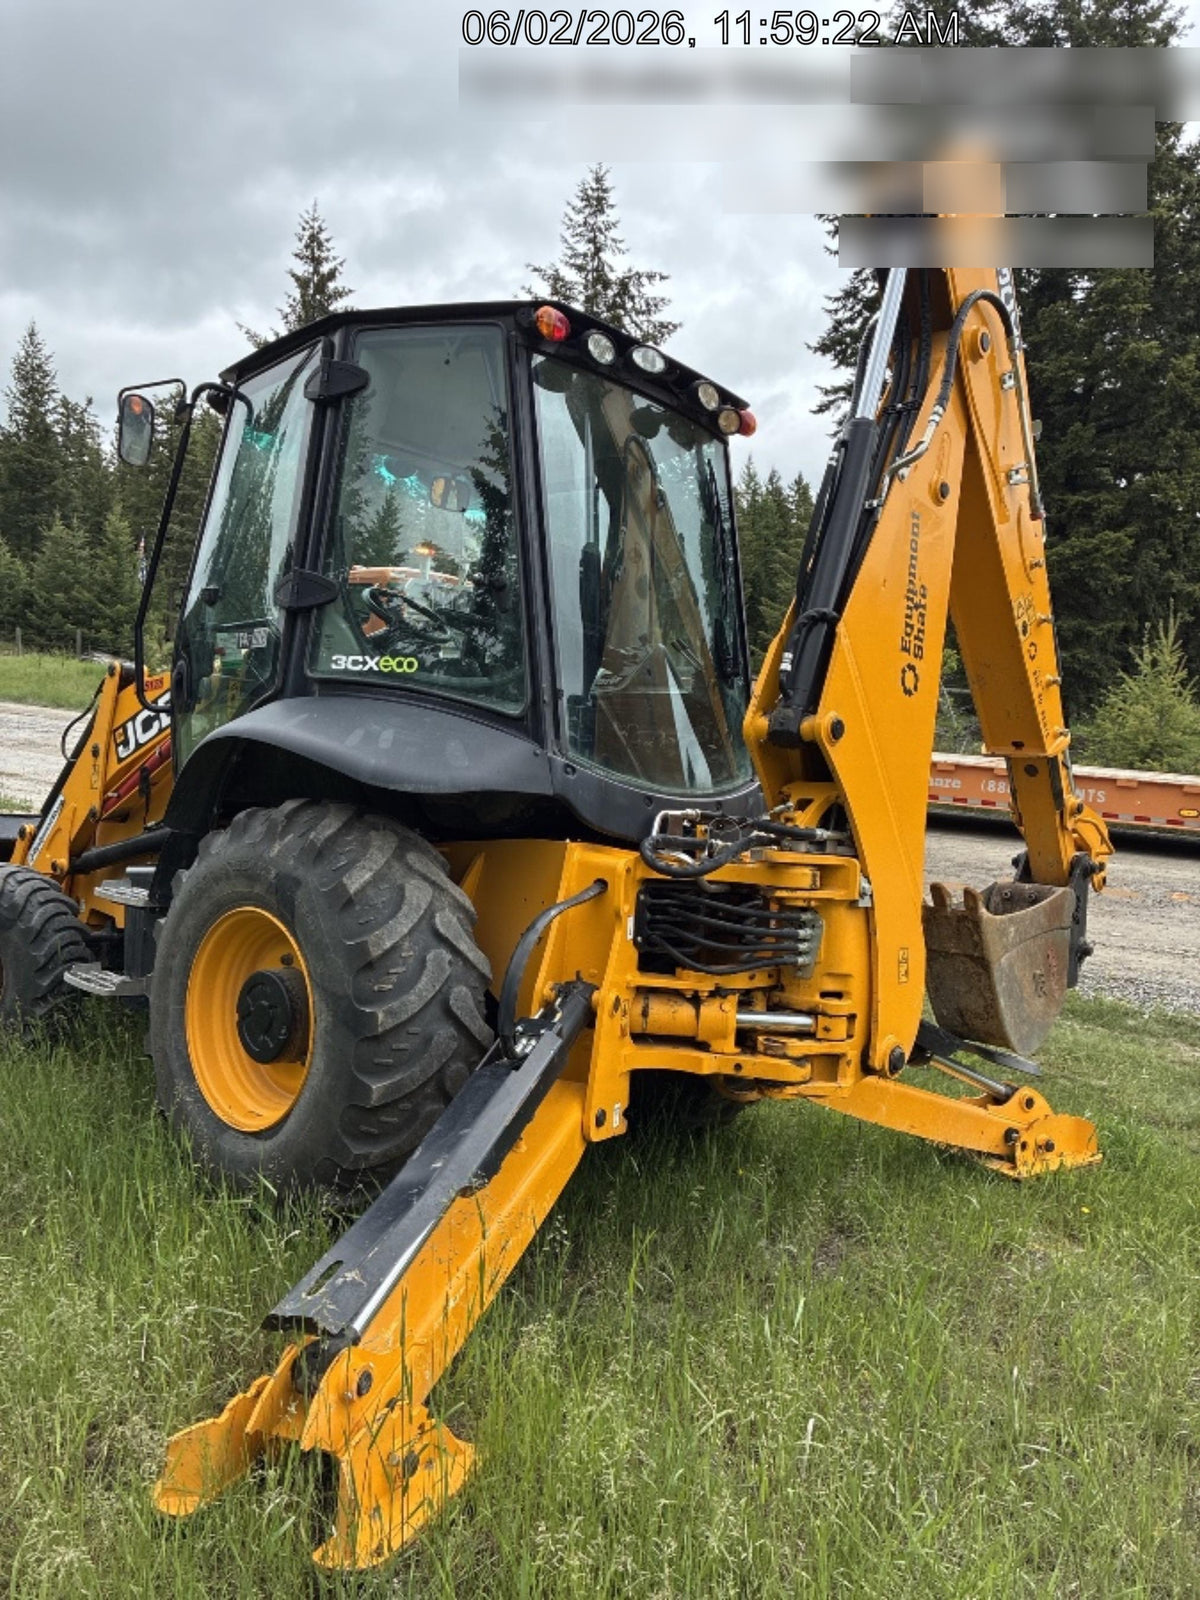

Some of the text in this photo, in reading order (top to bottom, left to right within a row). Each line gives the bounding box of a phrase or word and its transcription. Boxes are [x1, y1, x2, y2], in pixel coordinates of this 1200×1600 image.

[901, 509, 921, 657] Equipment
[913, 583, 929, 661] Share
[981, 780, 1011, 794] (88
